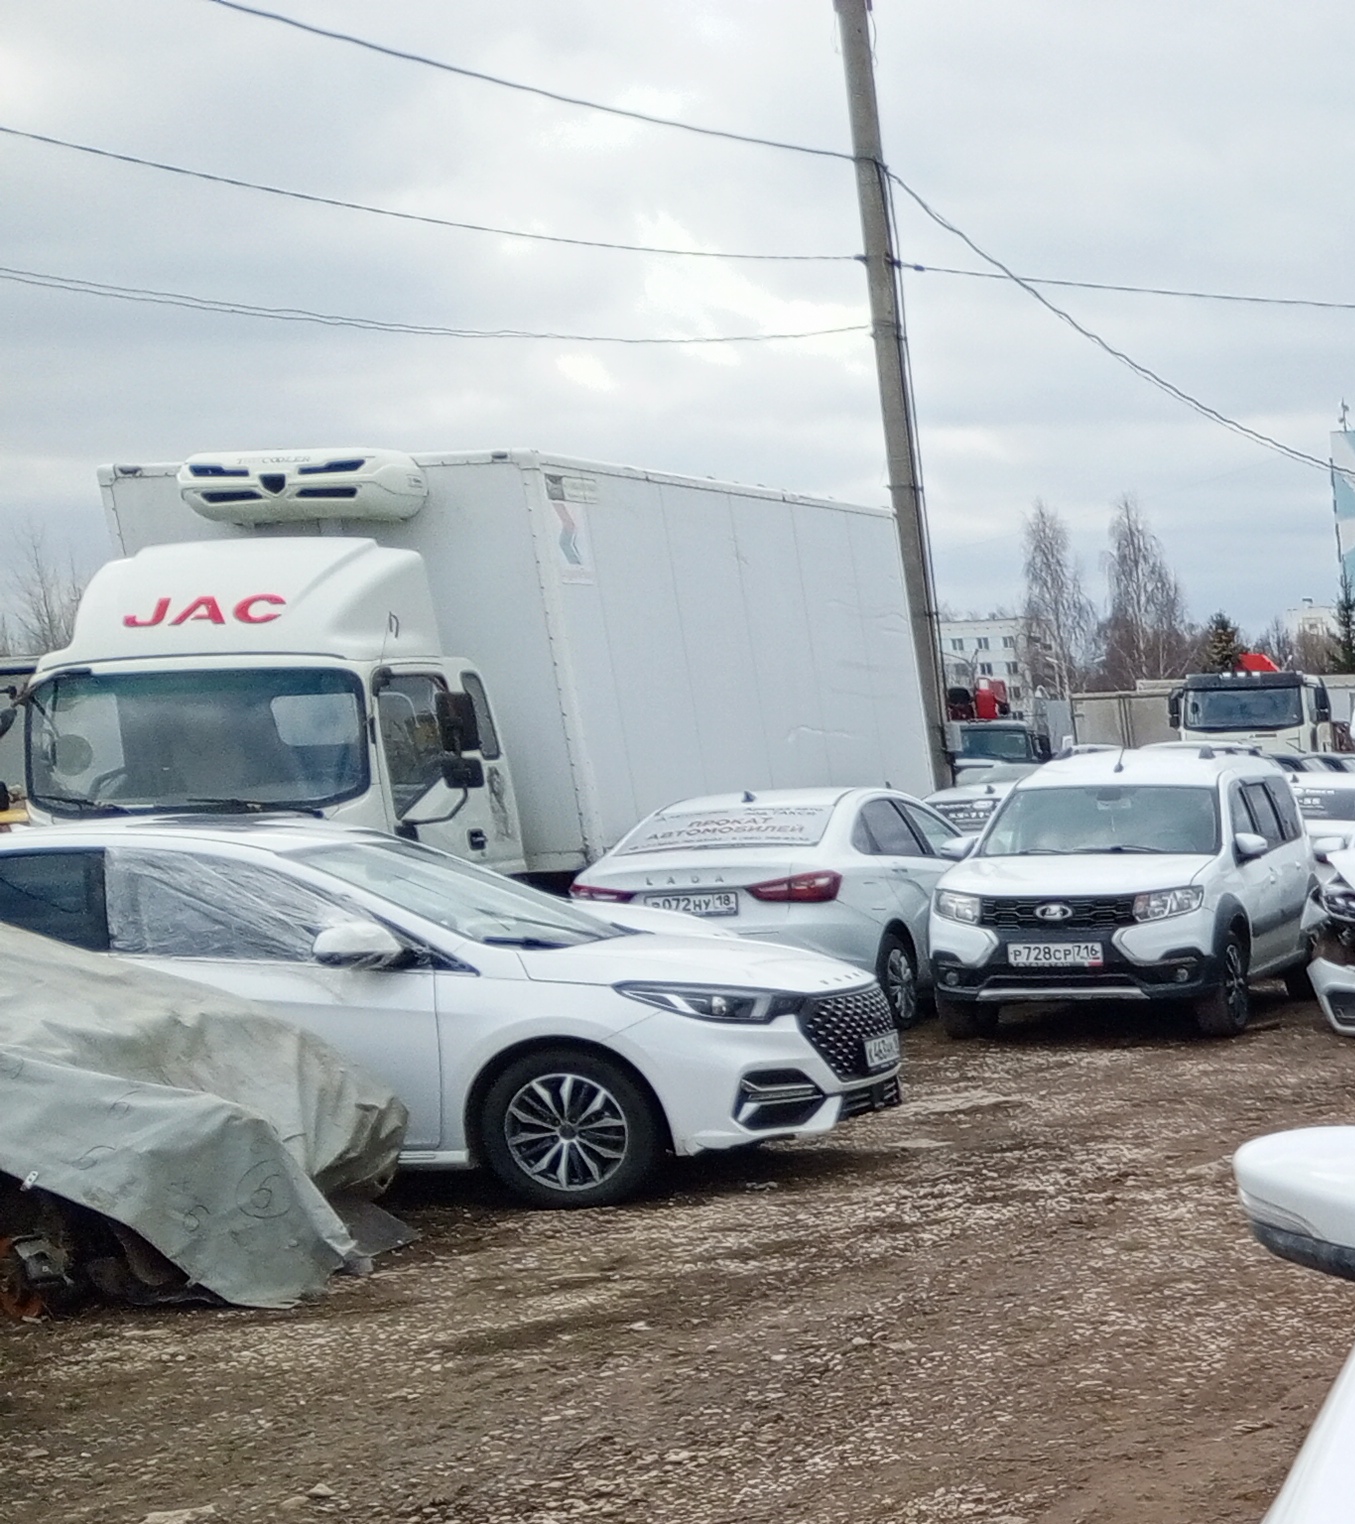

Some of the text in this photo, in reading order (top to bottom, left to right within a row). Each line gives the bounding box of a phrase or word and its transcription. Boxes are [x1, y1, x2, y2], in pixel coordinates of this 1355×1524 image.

[122, 593, 287, 628] JAC
[688, 816, 774, 828] ПРОКАТ
[647, 824, 804, 841] АВТОМОБИЛЕЙ
[646, 875, 724, 886] LADA
[715, 894, 731, 906] 18
[1013, 944, 1098, 961] Р728СР 716
